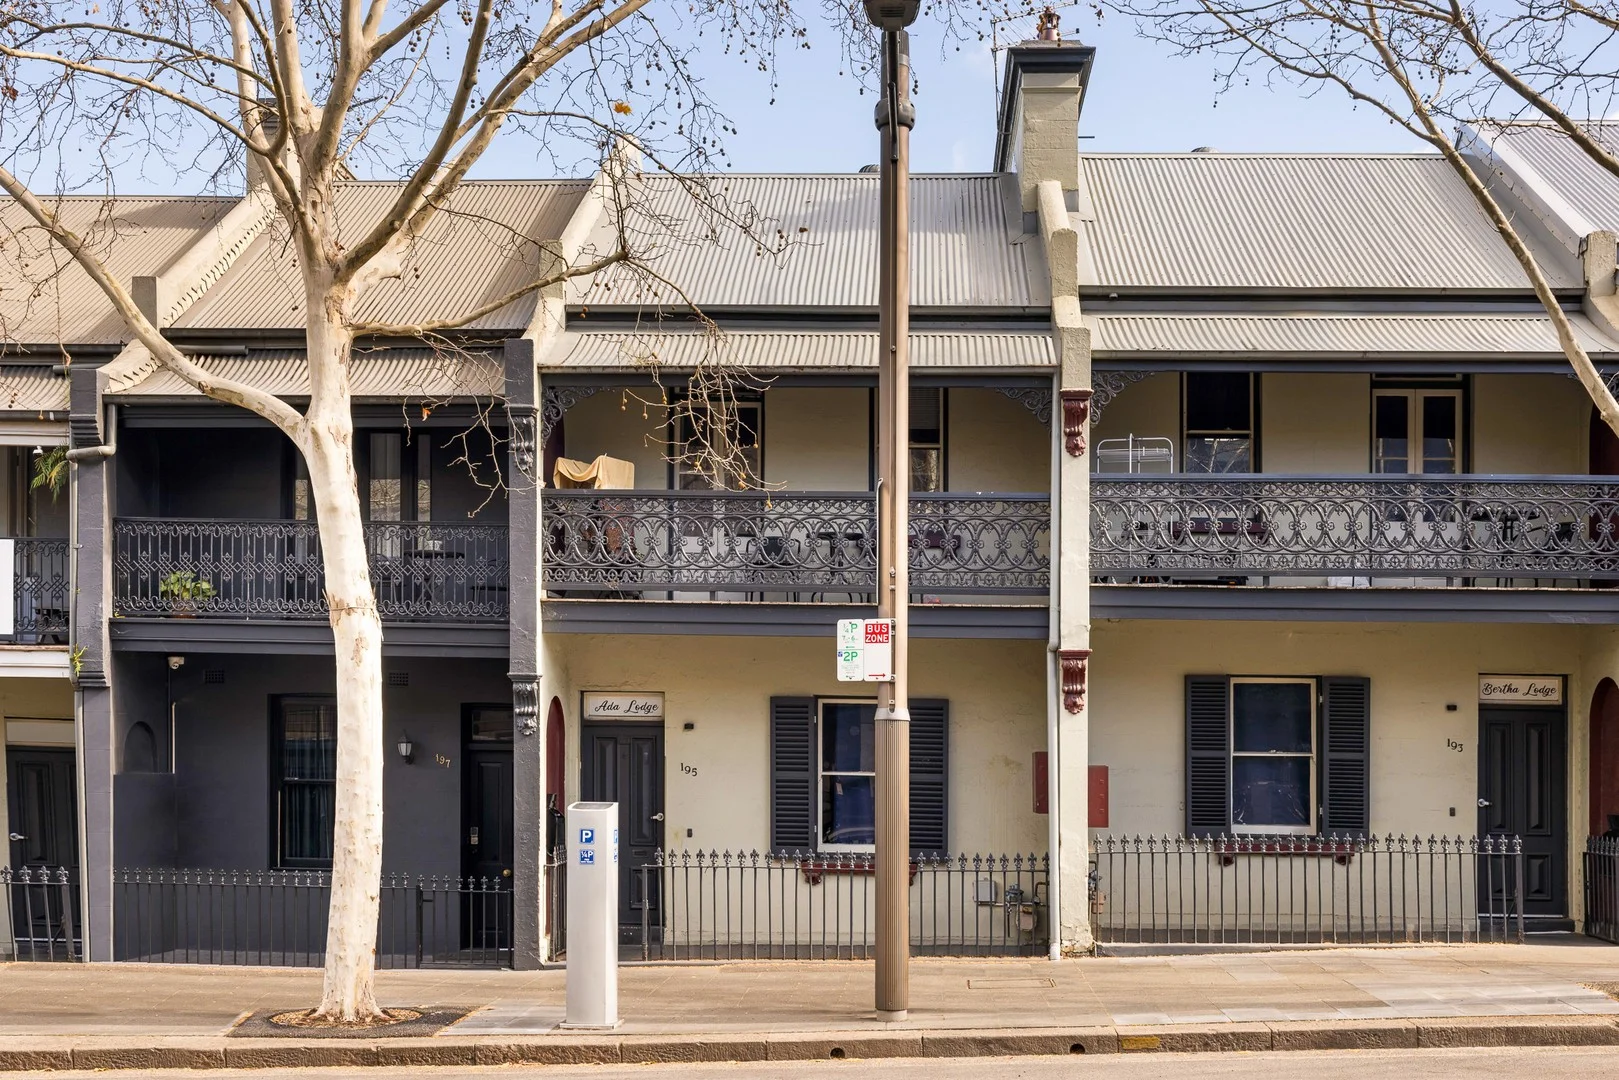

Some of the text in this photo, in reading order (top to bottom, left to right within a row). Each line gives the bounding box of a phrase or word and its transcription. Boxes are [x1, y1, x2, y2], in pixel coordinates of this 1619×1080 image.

[867, 624, 887, 633] BUS
[865, 634, 889, 642] ZONE
[843, 651, 858, 661] 2P
[1482, 682, 1557, 697] Bertha Lodge
[594, 699, 659, 714] Ada Lodge
[1447, 738, 1464, 753] 193
[435, 753, 451, 768] 197
[680, 762, 698, 777] 195
[582, 830, 592, 843] P
